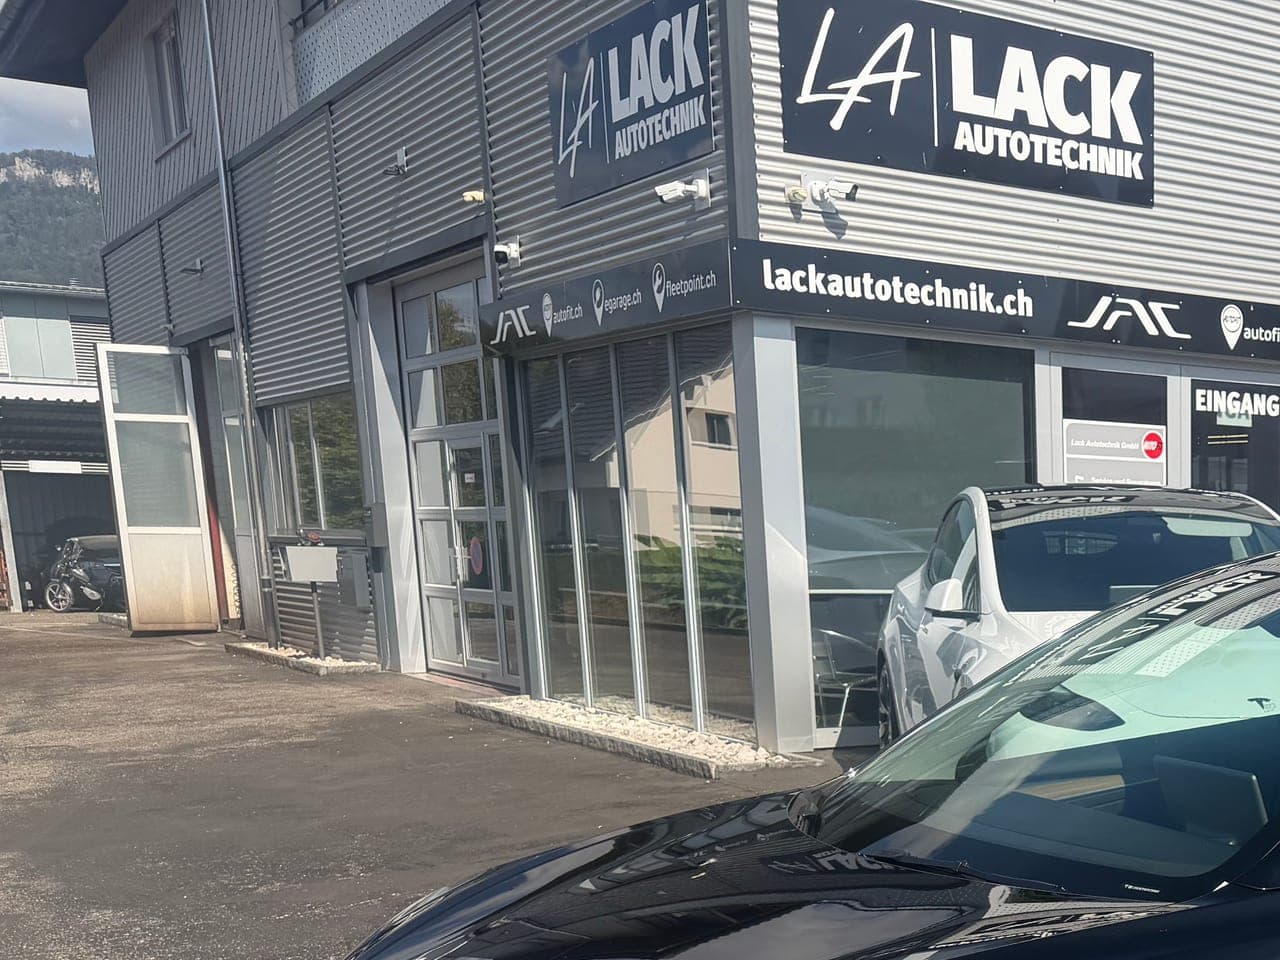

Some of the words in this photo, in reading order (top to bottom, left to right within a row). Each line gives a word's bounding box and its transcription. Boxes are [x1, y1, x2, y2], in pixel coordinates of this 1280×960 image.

[608, 4, 705, 123] LACK
[796, 8, 921, 131] LA
[950, 34, 1144, 145] LACK
[615, 94, 706, 160] AUTOTECHNIK
[953, 121, 1144, 180] AUTOTECHNIK
[604, 289, 642, 313] egarage.ch
[666, 270, 716, 297] fleetpoint.ch
[762, 258, 1033, 317] lackautotechnik.ch
[552, 303, 583, 324] autofit.ch
[1195, 388, 1280, 417] EINGANG
